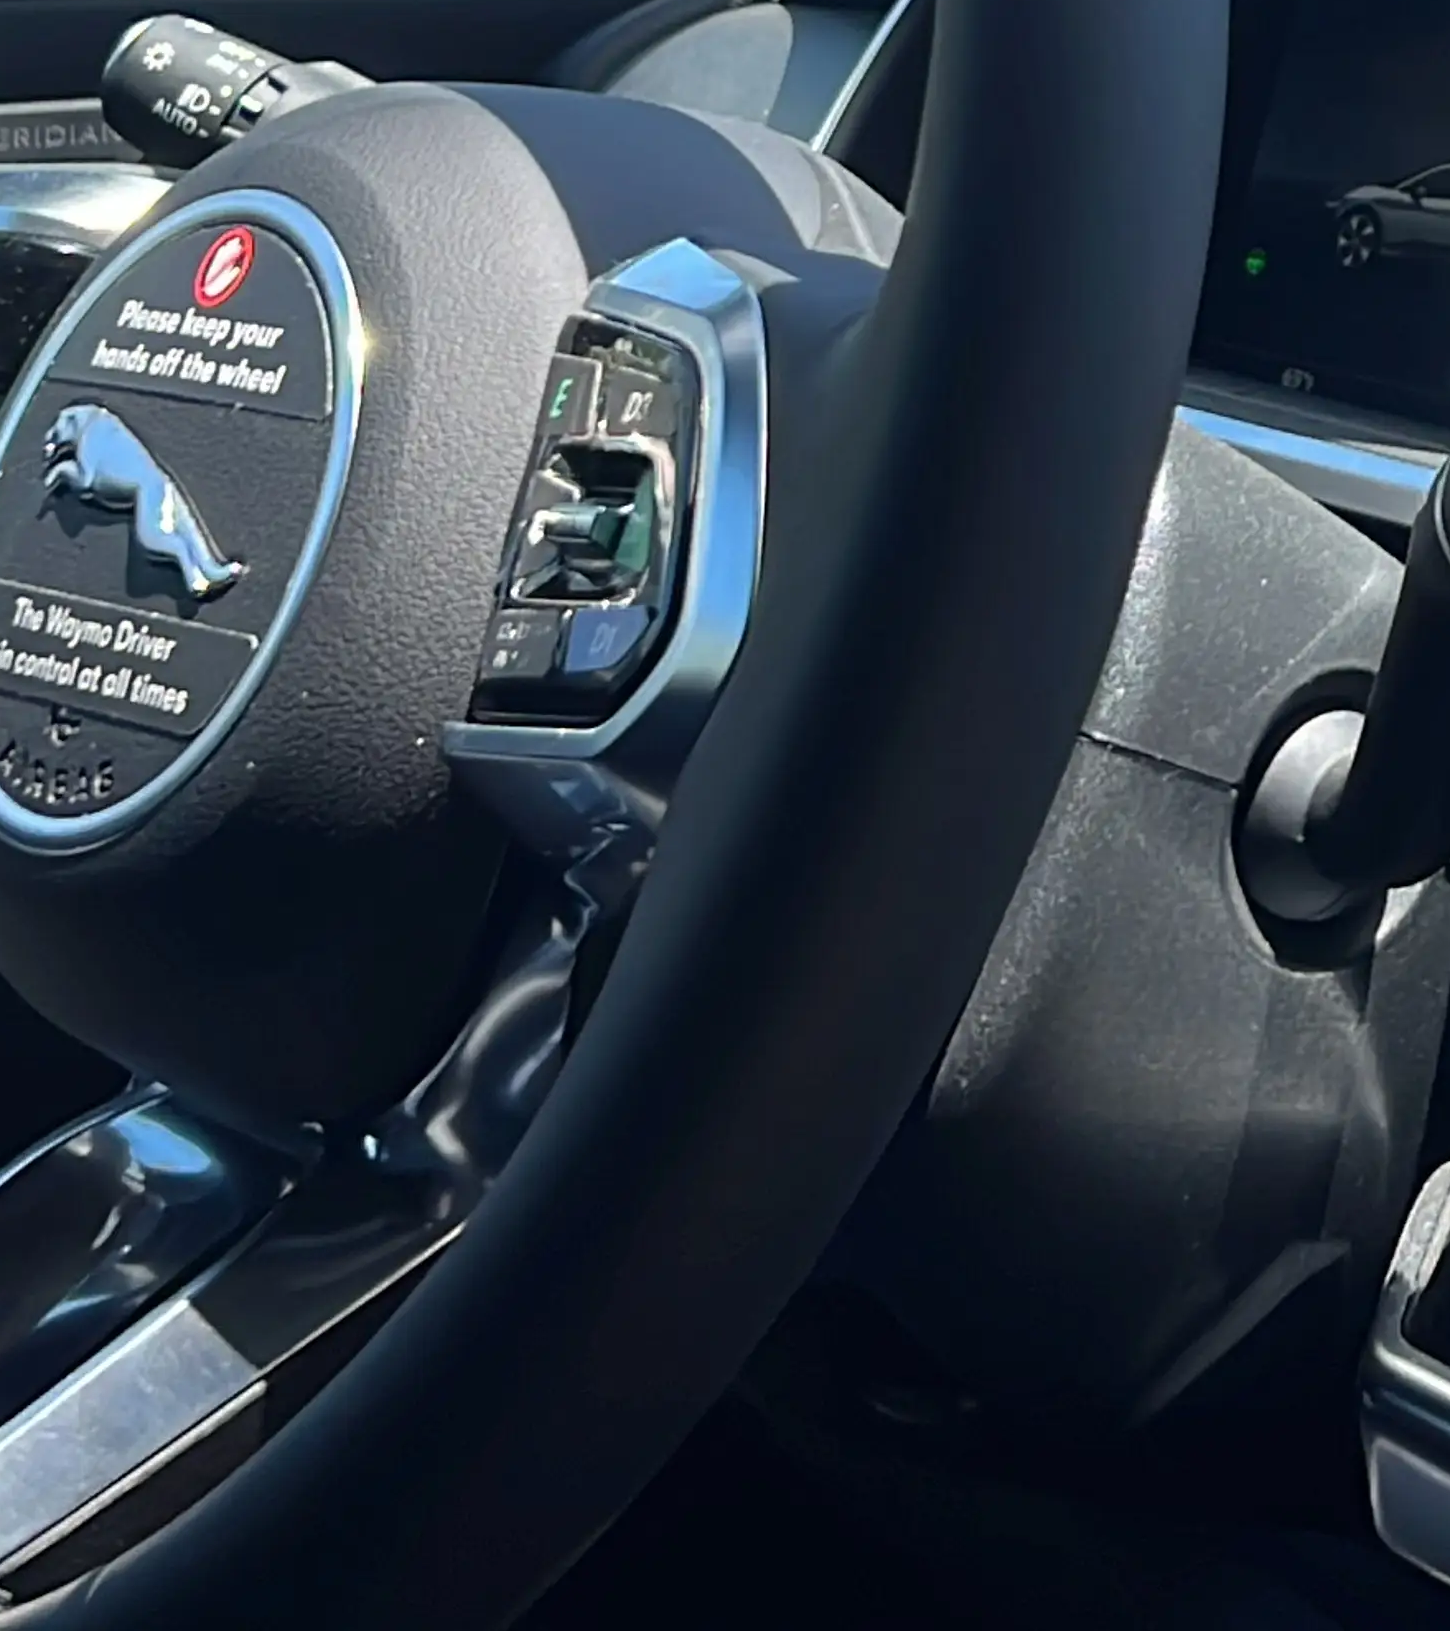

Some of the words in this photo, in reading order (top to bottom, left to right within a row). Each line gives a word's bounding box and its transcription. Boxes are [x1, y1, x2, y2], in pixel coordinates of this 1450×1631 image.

[152, 98, 199, 137] AUTO
[116, 299, 182, 335] Please
[179, 306, 232, 348] keep
[226, 320, 285, 351] your
[90, 338, 152, 375] hands
[149, 346, 186, 379] off
[179, 351, 218, 384] the
[216, 358, 288, 396] wheel
[11, 595, 45, 633] The
[44, 603, 113, 650] Waymo
[112, 619, 178, 663] Driver
[12, 650, 81, 687] control
[76, 663, 103, 694] at
[101, 667, 134, 700] all
[129, 673, 190, 716] times
